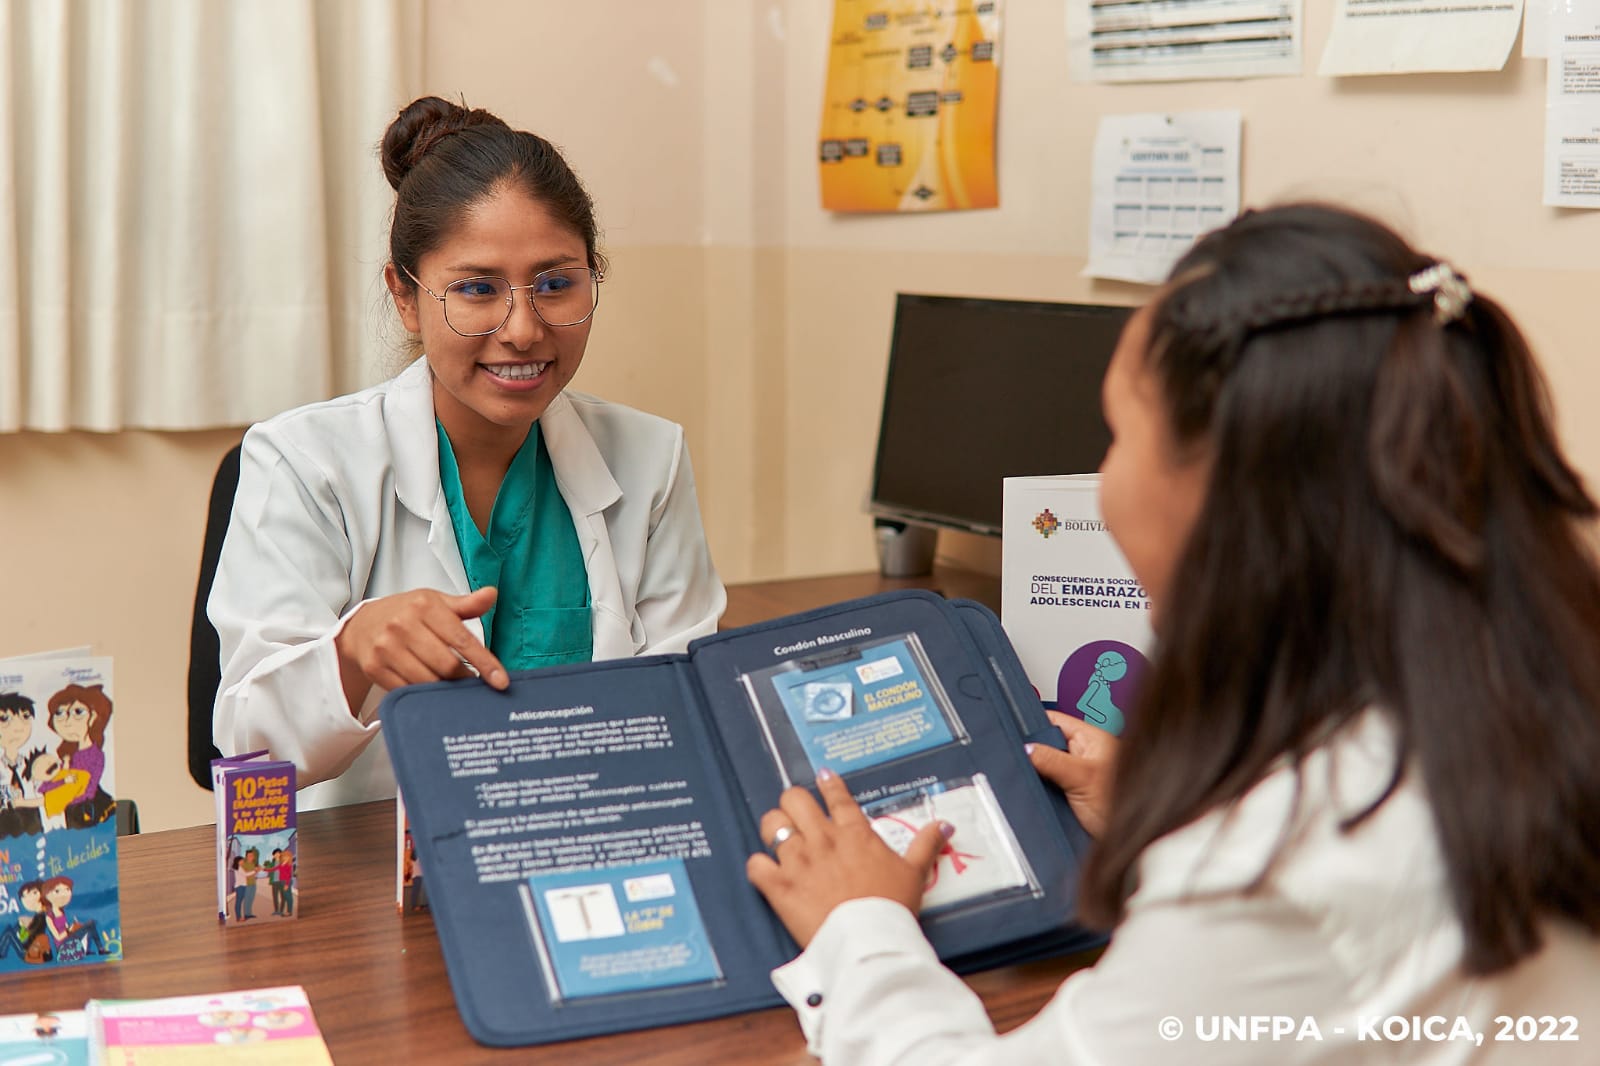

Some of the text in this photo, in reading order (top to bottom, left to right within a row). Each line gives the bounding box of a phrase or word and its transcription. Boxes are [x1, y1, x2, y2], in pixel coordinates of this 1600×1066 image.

[1031, 583, 1056, 595] DEL
[1032, 575, 1105, 585] CONSECUENCIAS
[1030, 596, 1121, 609] ADOLESCENCIA
[1125, 600, 1140, 610] EN
[773, 627, 872, 656] Condón Masculino
[864, 680, 917, 704] EL CONDÓN
[868, 689, 923, 712] MASCULINO
[509, 705, 595, 721] Anticoncepción
[233, 776, 256, 800] 10
[233, 814, 287, 833] AMARME
[66, 836, 110, 869] decides
